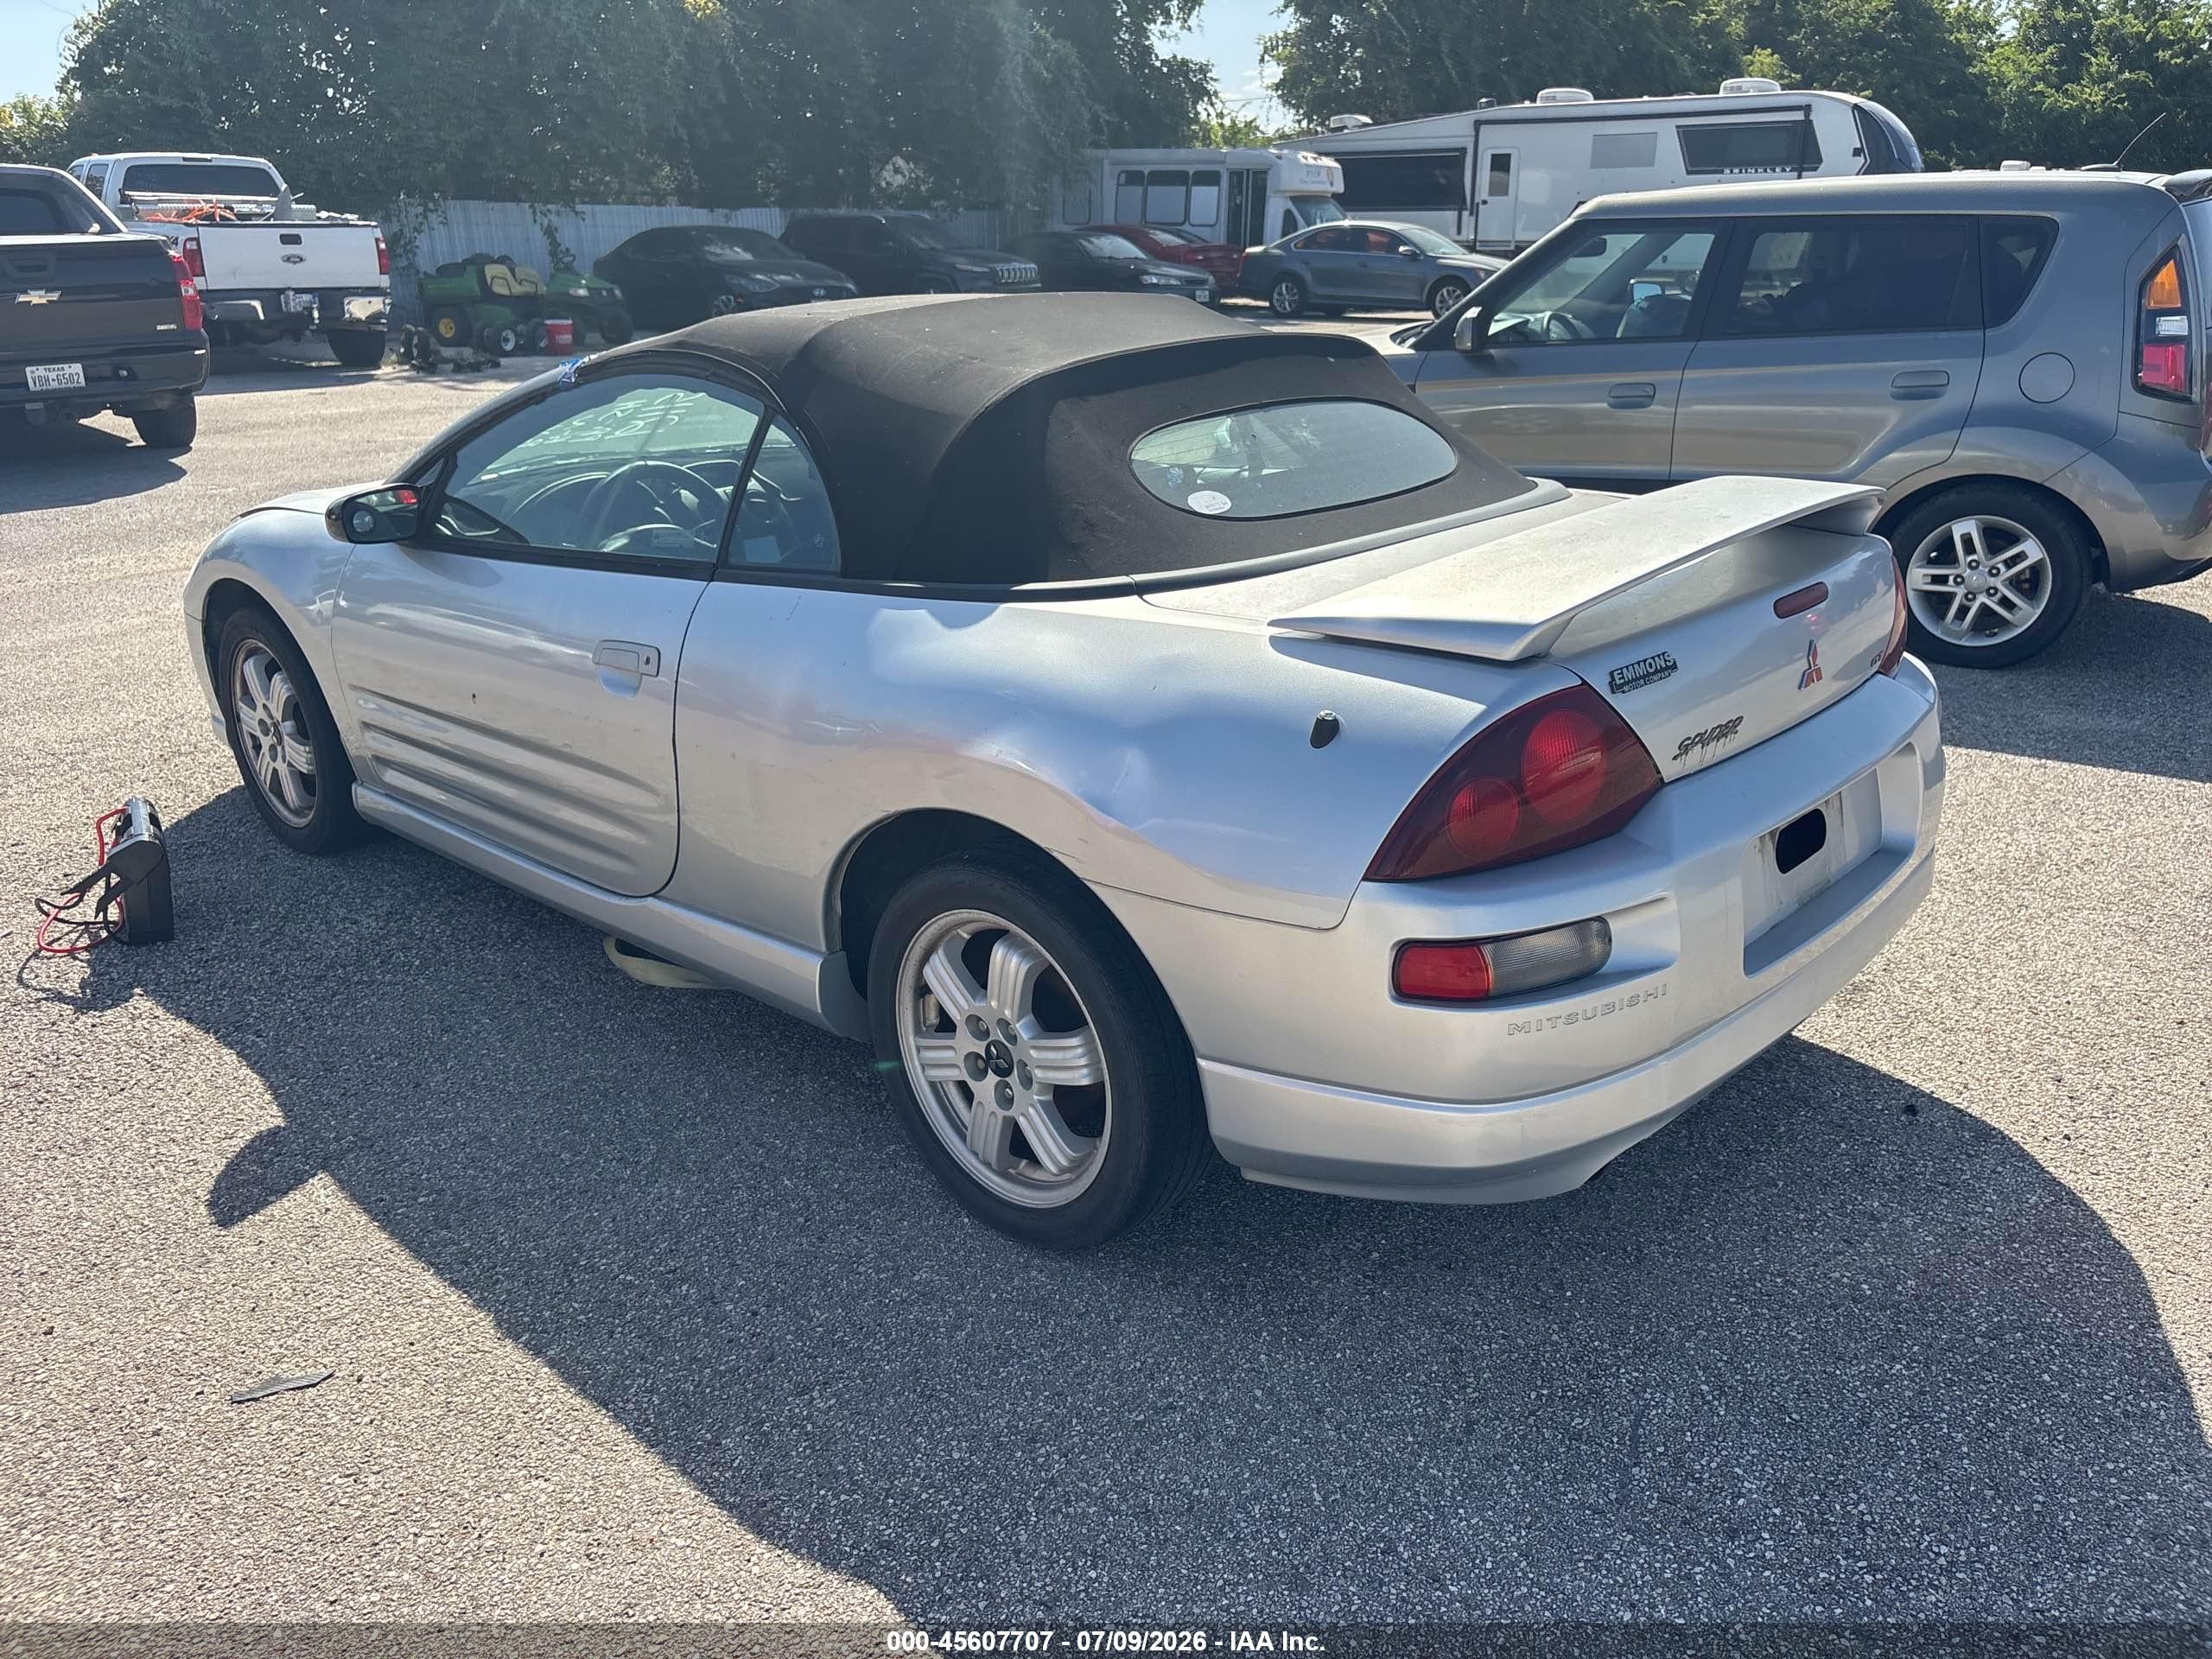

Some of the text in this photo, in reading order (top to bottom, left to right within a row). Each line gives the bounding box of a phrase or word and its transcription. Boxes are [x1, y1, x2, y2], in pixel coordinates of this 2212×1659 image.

[1724, 166, 1792, 175] BRINKLEY
[1613, 652, 1674, 685] EMMONS
[1624, 668, 1673, 692] MOTOR COMPANY
[1671, 715, 1745, 762] SPYDER
[1507, 983, 1668, 1036] MITSUBISHI
